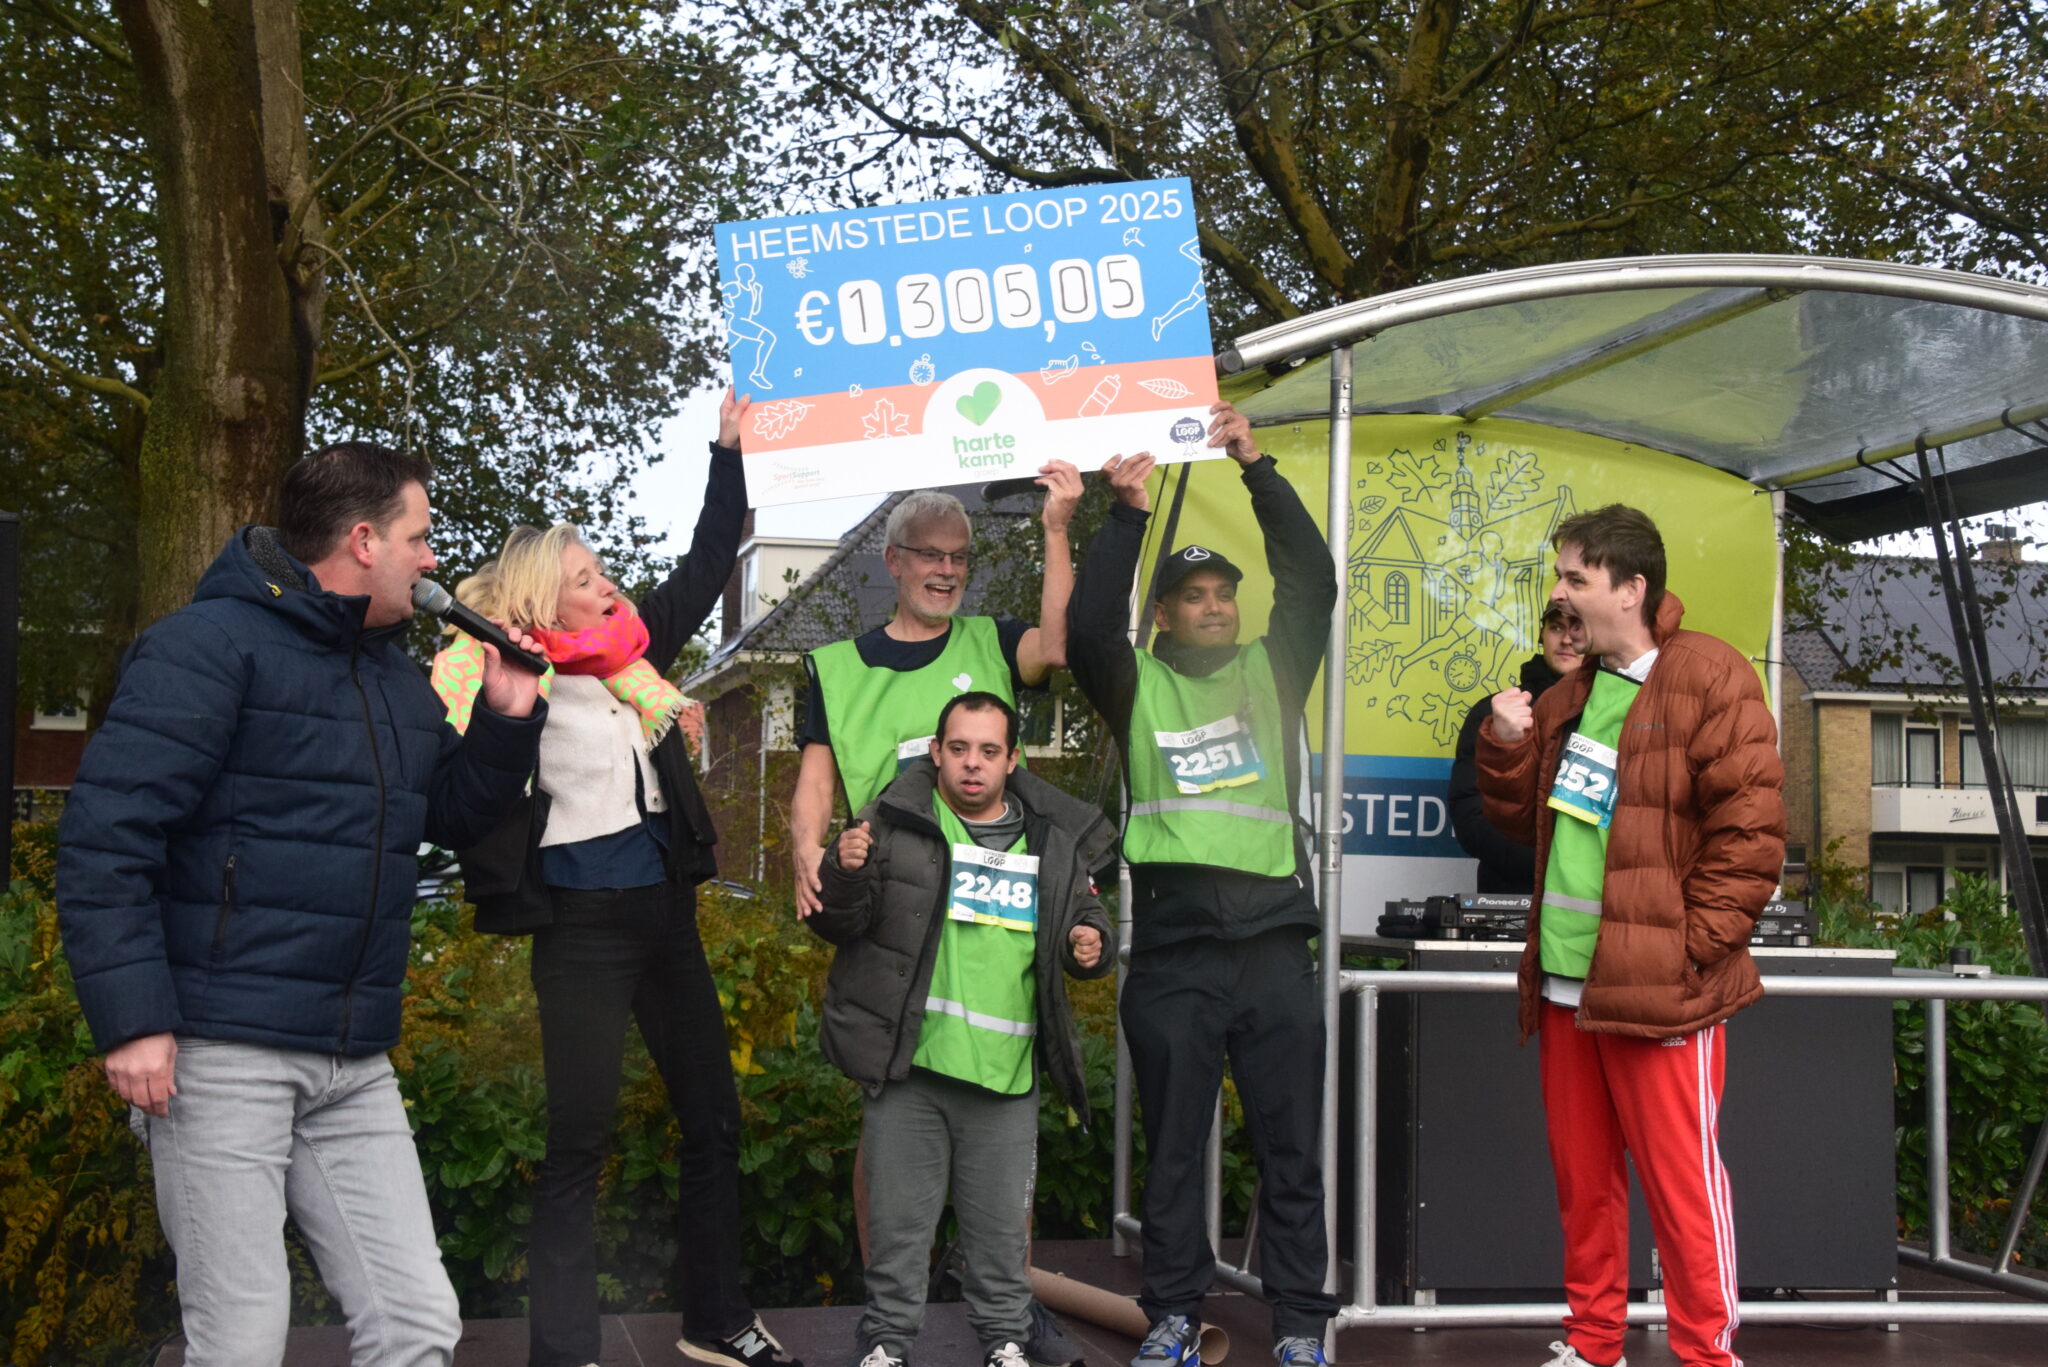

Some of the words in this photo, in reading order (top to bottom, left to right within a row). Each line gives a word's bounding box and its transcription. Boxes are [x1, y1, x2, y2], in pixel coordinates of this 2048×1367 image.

[731, 208, 972, 262] HEEMSTEDE
[983, 197, 1089, 234] LOOP
[1100, 189, 1183, 224] 2025
[952, 432, 1016, 454] harte
[958, 452, 1015, 469] kamp
[1181, 730, 1207, 745] LOOP
[1170, 741, 1244, 776] 2251
[983, 855, 1006, 867] LOOP
[953, 871, 1032, 909] 2248
[1477, 897, 1519, 906] Pioneer
[1661, 1039, 1687, 1047] adidas
